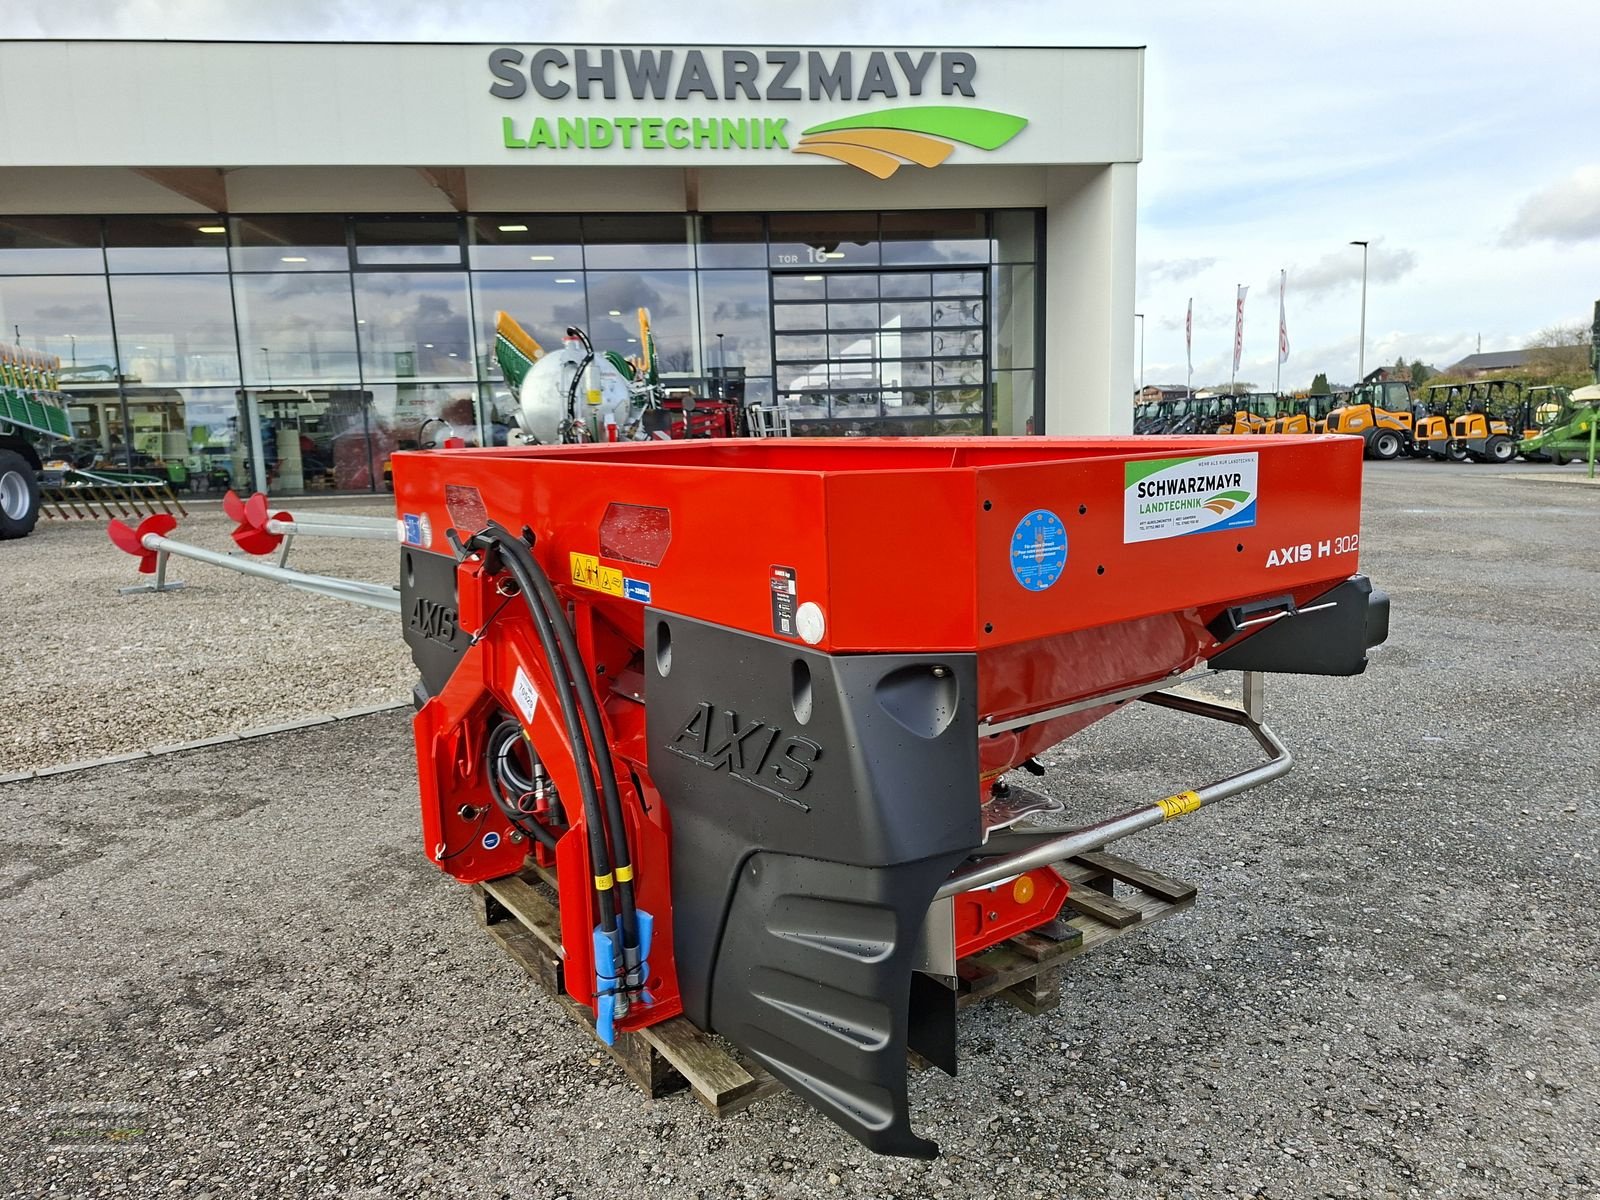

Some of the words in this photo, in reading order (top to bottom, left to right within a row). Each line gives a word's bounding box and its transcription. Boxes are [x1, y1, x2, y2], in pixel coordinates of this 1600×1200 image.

[488, 47, 977, 101] SCHWARZMAYR
[503, 116, 789, 150] LANDTECHNIK
[778, 255, 799, 264] TOR
[807, 246, 828, 263] 16
[1137, 473, 1241, 498] SCHWARZMAYR
[1139, 498, 1202, 514] LANDTECHNIK
[1265, 543, 1312, 568] AXIS
[1317, 539, 1331, 558] H
[1334, 534, 1359, 555] 30.2
[409, 597, 456, 642] AXIS
[671, 701, 823, 791] AXIS
